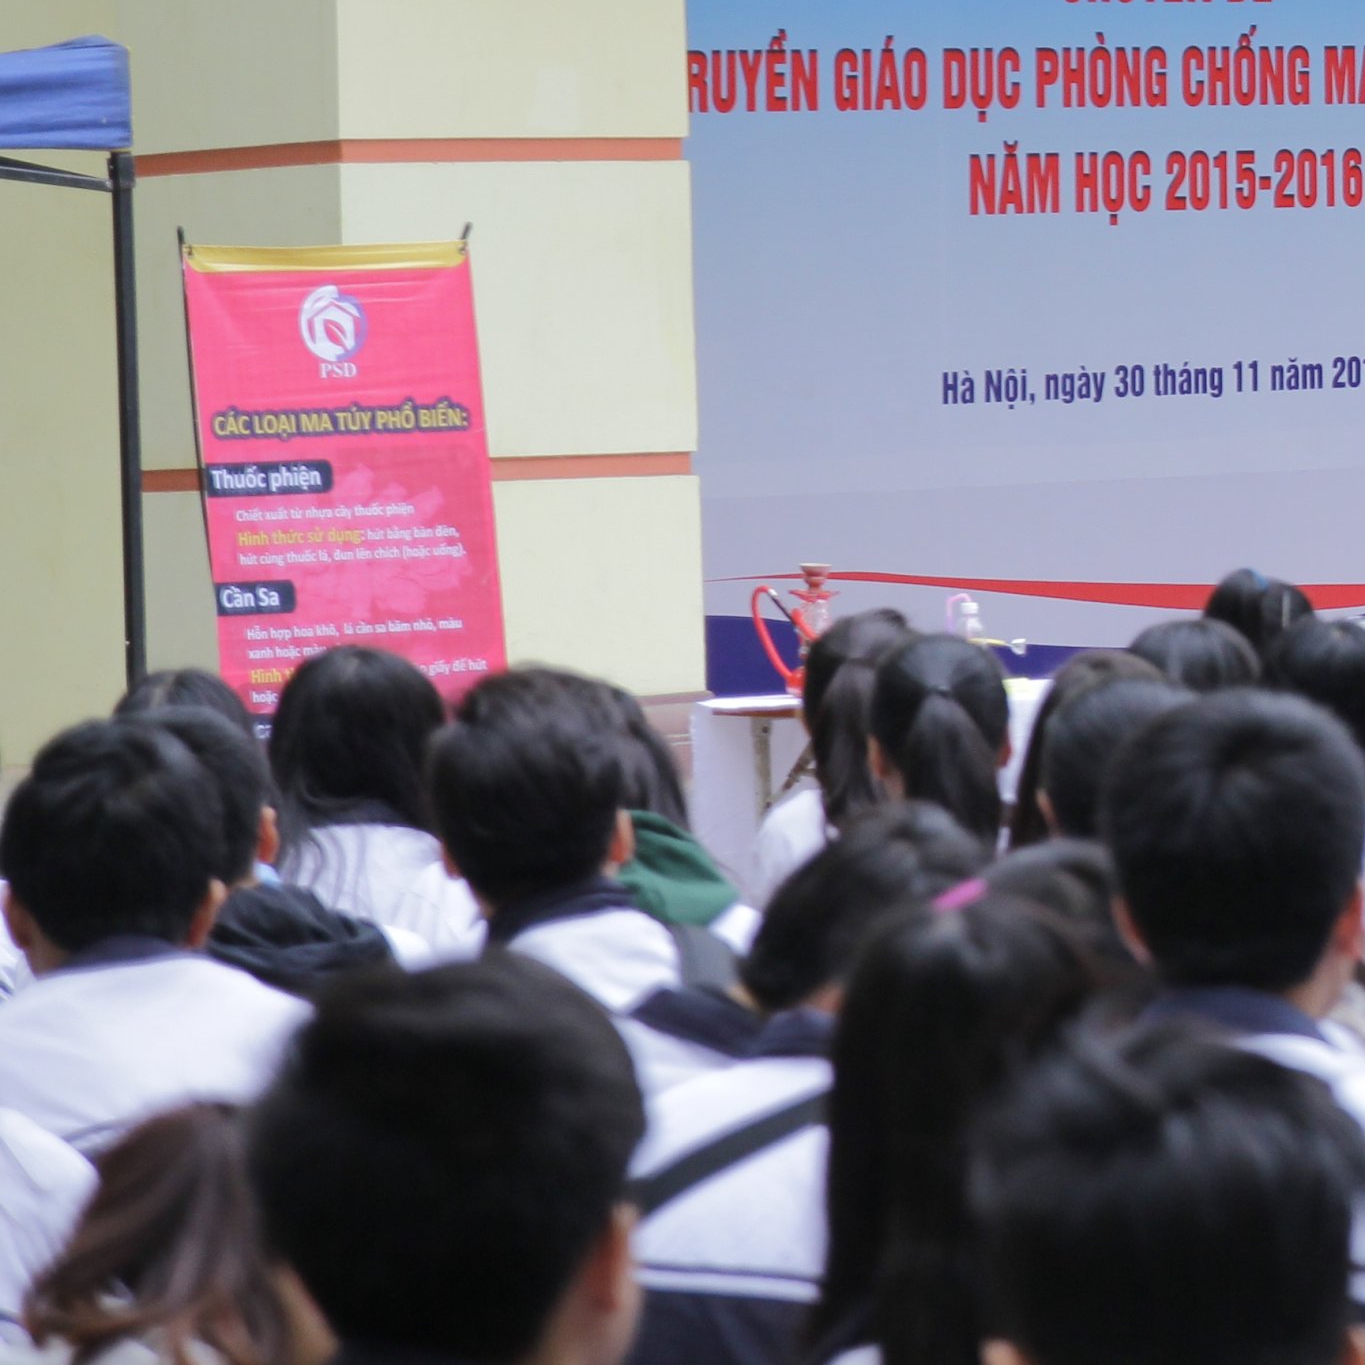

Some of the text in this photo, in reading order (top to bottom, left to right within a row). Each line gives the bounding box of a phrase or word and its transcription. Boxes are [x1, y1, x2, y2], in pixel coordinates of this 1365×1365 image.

[686, 28, 818, 113] RUYỀN
[834, 35, 927, 111] GIÁO
[943, 47, 1021, 123] DỤC
[1035, 31, 1168, 108] PHÒNG
[1181, 24, 1310, 107] CHỐNG
[968, 139, 1363, 226] NĂM HỌC 2015-2016
[319, 362, 358, 379] PSD
[941, 370, 975, 405] Hà
[983, 368, 1037, 410] Nội,
[1044, 365, 1106, 403] ngày
[1113, 364, 1146, 398] 30
[1152, 361, 1224, 398] tháng
[1233, 359, 1260, 393] 11
[1269, 356, 1324, 391] năm
[213, 399, 469, 439] CÁC LOẠI MA TÚY PHỔ BIẾN:
[211, 464, 322, 492] Thuốc phiện
[222, 586, 280, 609] Cần Sa
